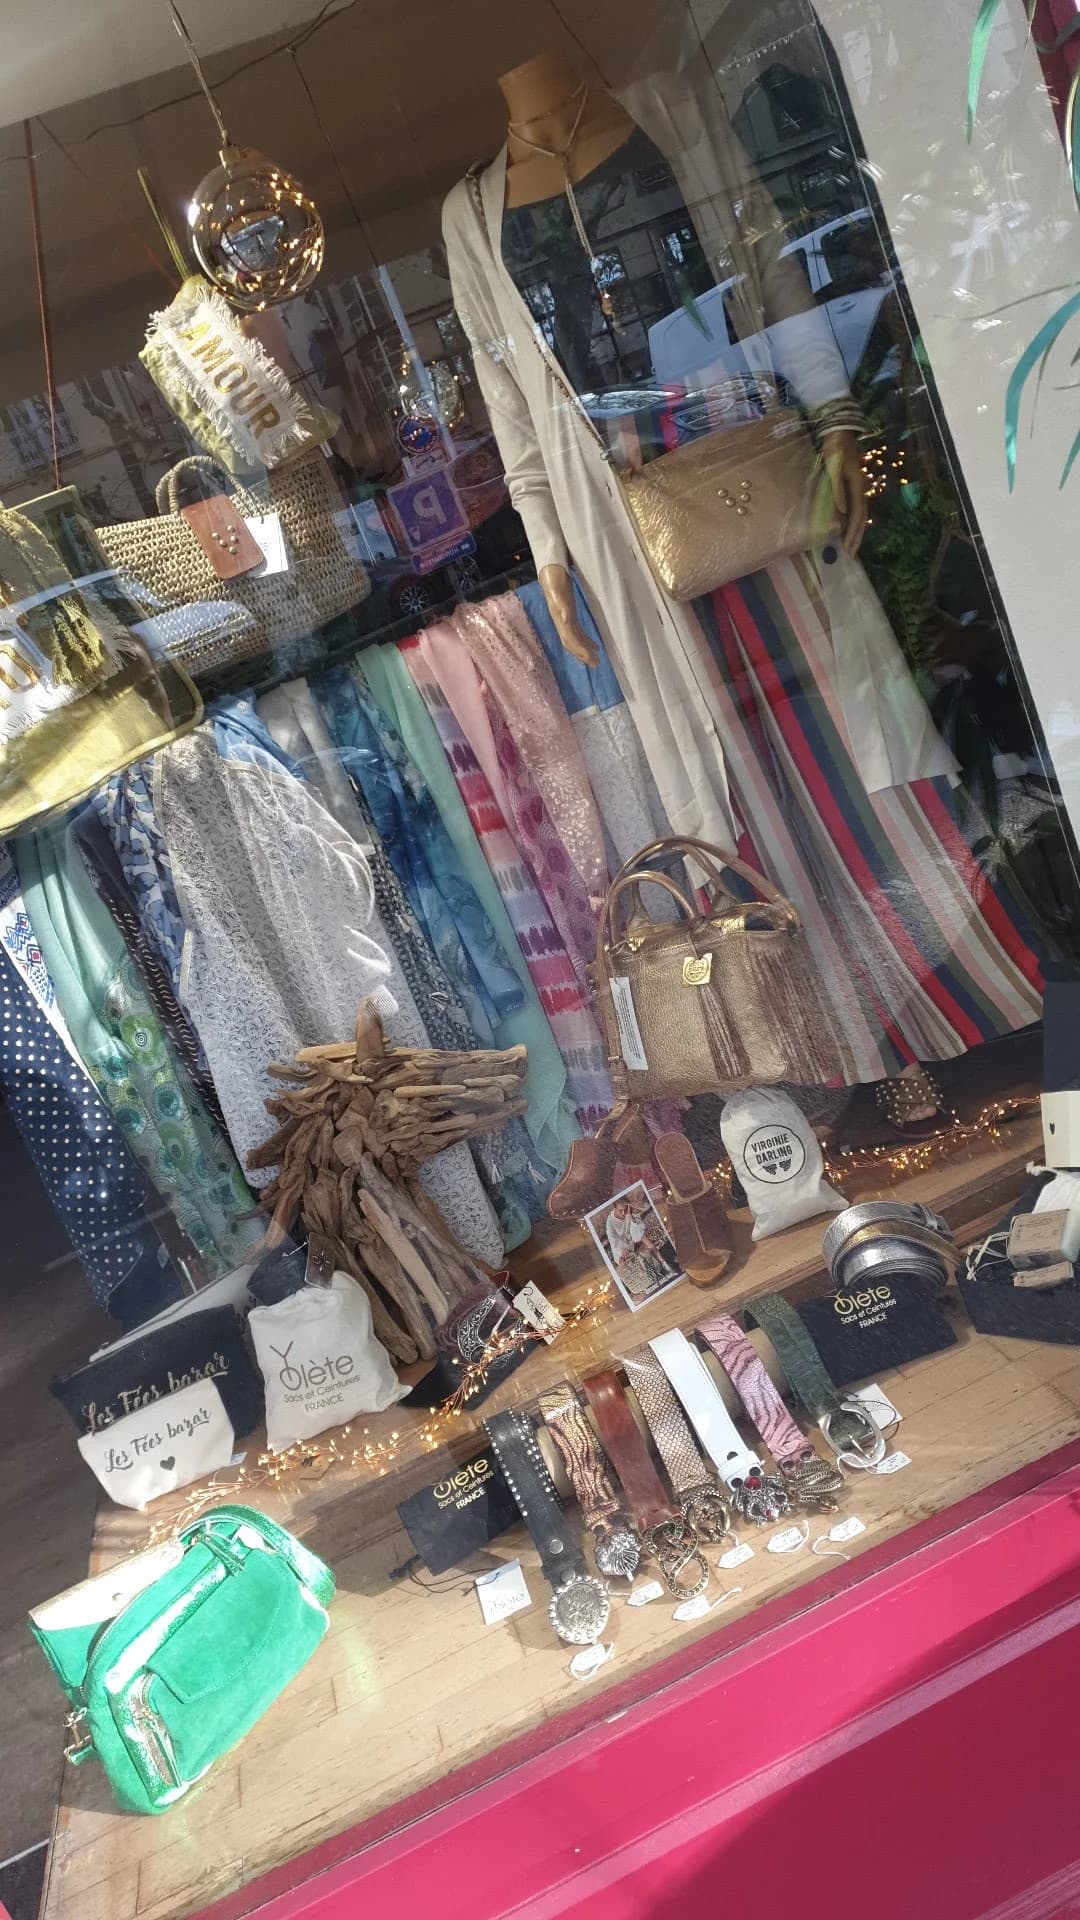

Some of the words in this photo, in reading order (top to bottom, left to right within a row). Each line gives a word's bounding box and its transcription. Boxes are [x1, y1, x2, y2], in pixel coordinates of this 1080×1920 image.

[176, 322, 281, 439] AMOUR
[751, 1133, 790, 1152] VIRGINIE
[756, 1145, 793, 1164] DARLING
[859, 1312, 888, 1329] FRANCE
[284, 1394, 304, 1404] Sacs
[316, 1375, 360, 1396] Ceintures
[304, 1393, 345, 1412] FRANCE
[104, 1448, 134, 1473] Les
[166, 1407, 211, 1439] bazar
[455, 1486, 486, 1510] FRANCE
